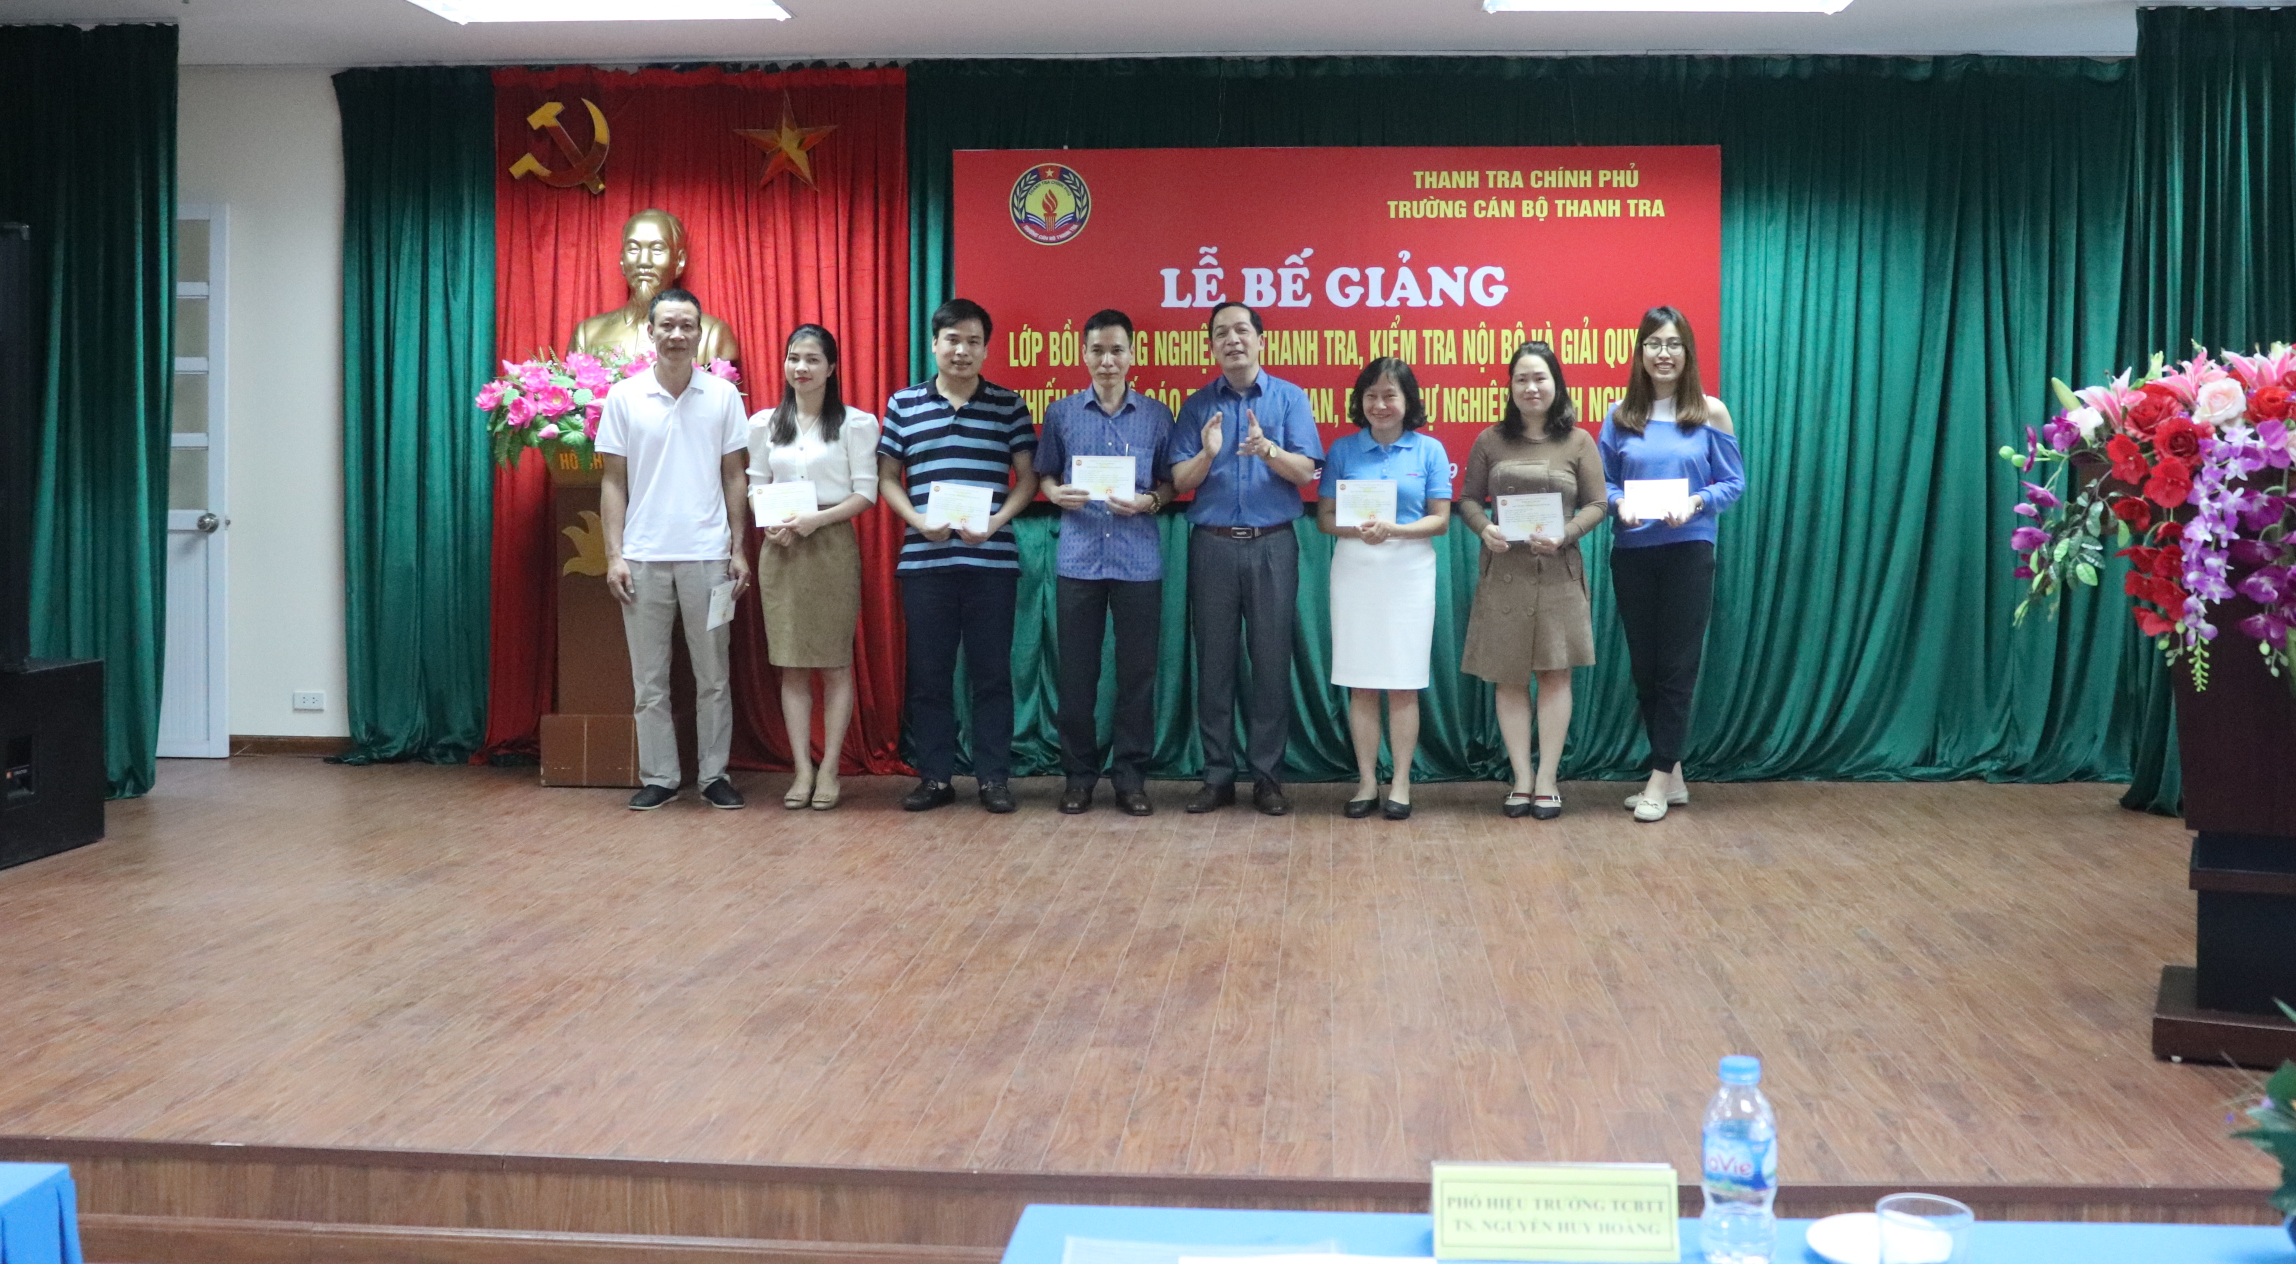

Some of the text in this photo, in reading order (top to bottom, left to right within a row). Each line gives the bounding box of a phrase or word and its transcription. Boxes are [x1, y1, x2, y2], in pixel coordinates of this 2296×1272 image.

[1413, 162, 1640, 189] THANH TRA CHÍNH PHỦ
[1387, 196, 1665, 221] TRƯỜNG CÁN BỘ THANH TRA
[1159, 246, 1509, 308] LỄ BẾ GIẢNG
[1009, 323, 1043, 367] LỚP
[1049, 318, 1080, 367] BỒI
[1154, 322, 1216, 375] NGHIỆ
[1323, 329, 1364, 370] TRA,
[1369, 314, 1417, 365] KIỂM
[1422, 329, 1457, 365] TRA
[1462, 321, 1495, 373] NỘI
[1560, 315, 1599, 365] GIẢI
[1604, 328, 1639, 369] QUY
[1447, 1193, 1483, 1210] PHÓ
